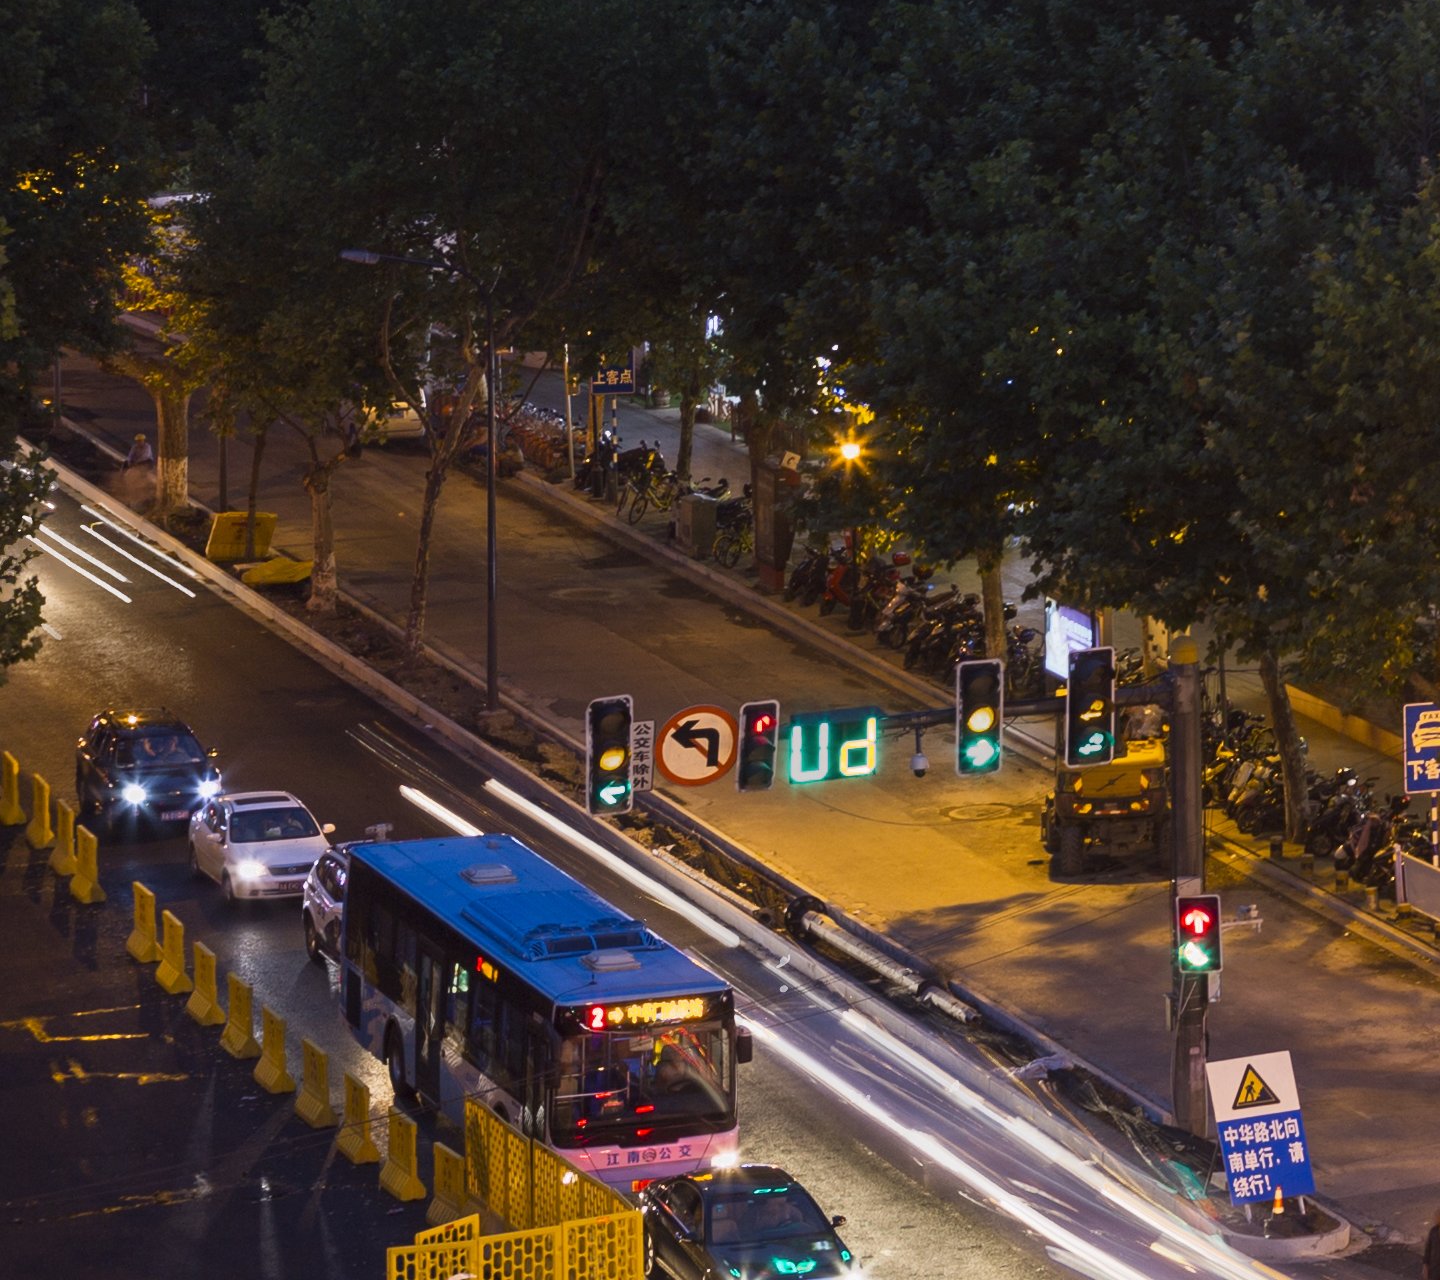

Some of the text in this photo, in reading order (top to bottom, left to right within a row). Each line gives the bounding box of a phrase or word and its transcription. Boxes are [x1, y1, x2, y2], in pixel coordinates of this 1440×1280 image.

[632, 723, 651, 788] 公交车除外
[591, 1006, 604, 1028] 2
[1223, 1117, 1300, 1148] 中华路北向
